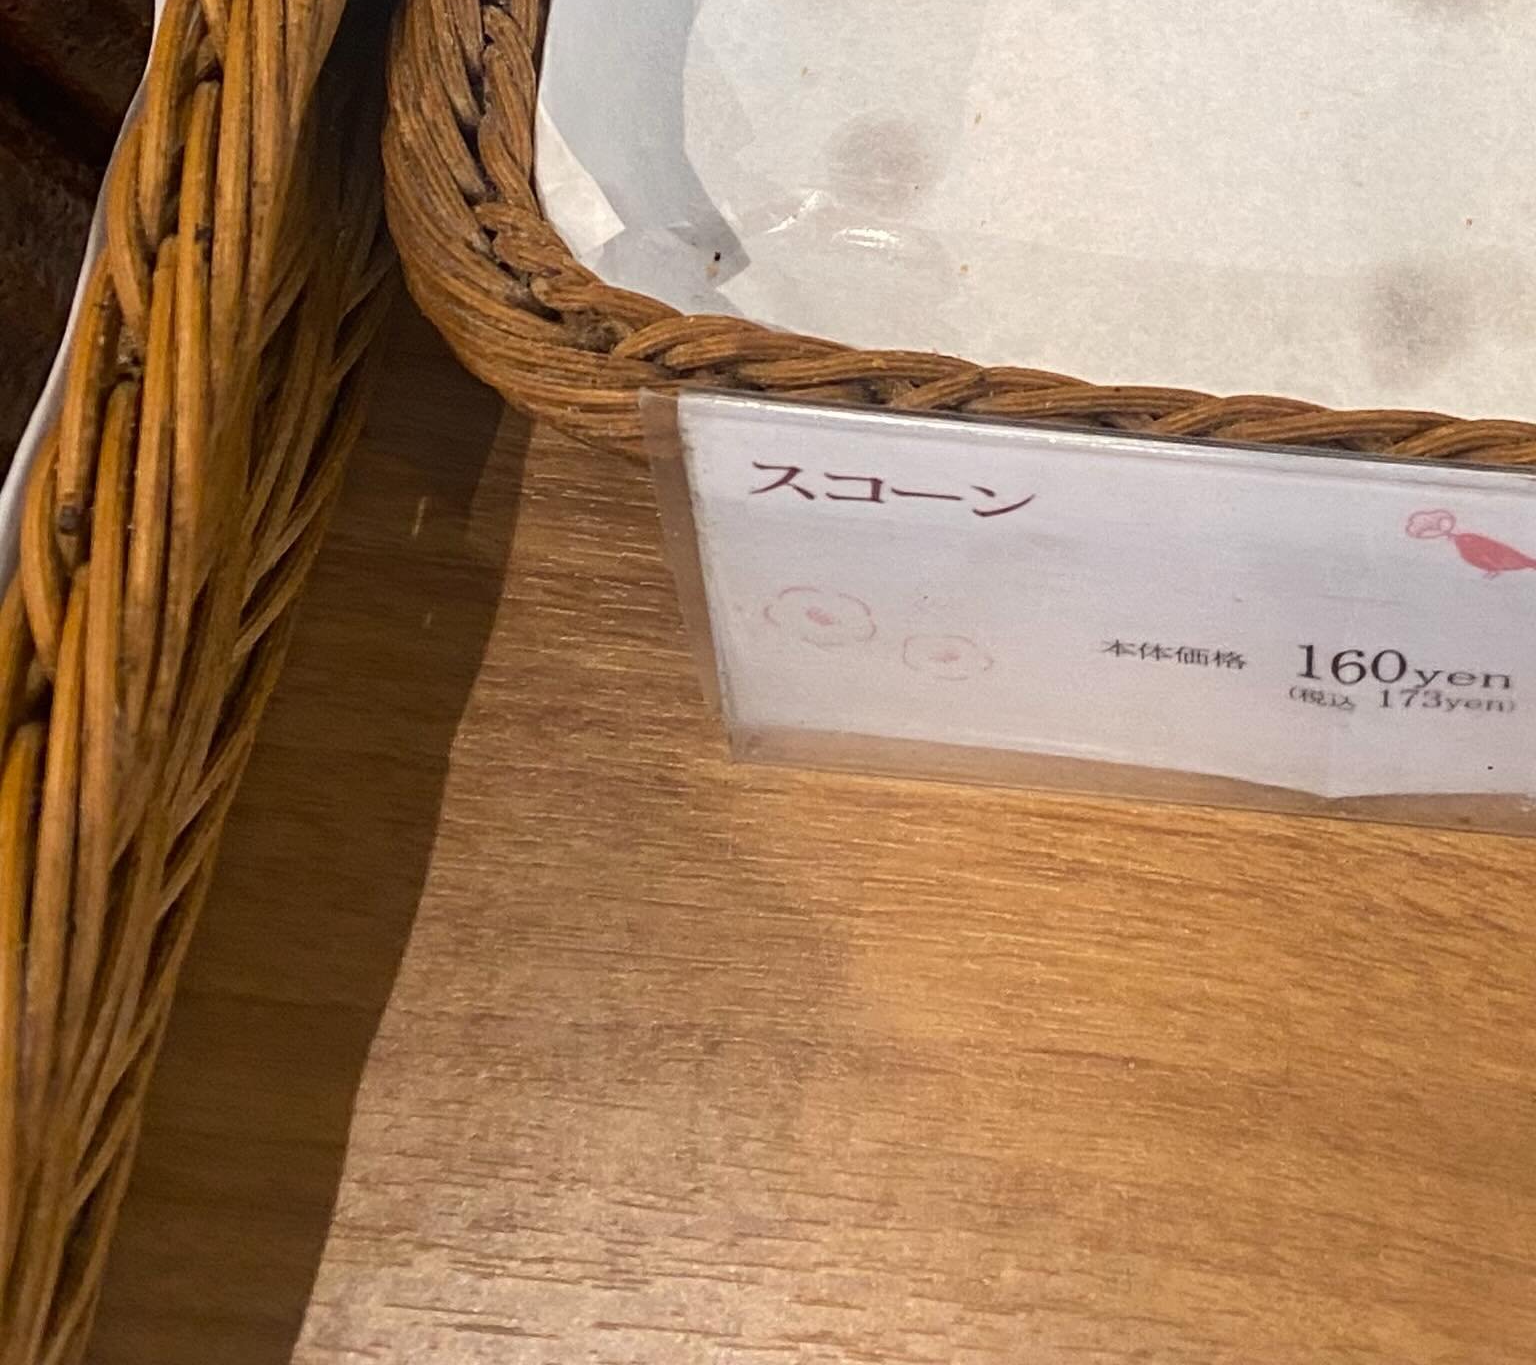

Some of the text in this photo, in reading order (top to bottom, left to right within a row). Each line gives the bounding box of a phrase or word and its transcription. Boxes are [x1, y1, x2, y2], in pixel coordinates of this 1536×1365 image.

[750, 461, 1036, 517] スコーン
[1102, 639, 1513, 689] 本体価格 160yen
